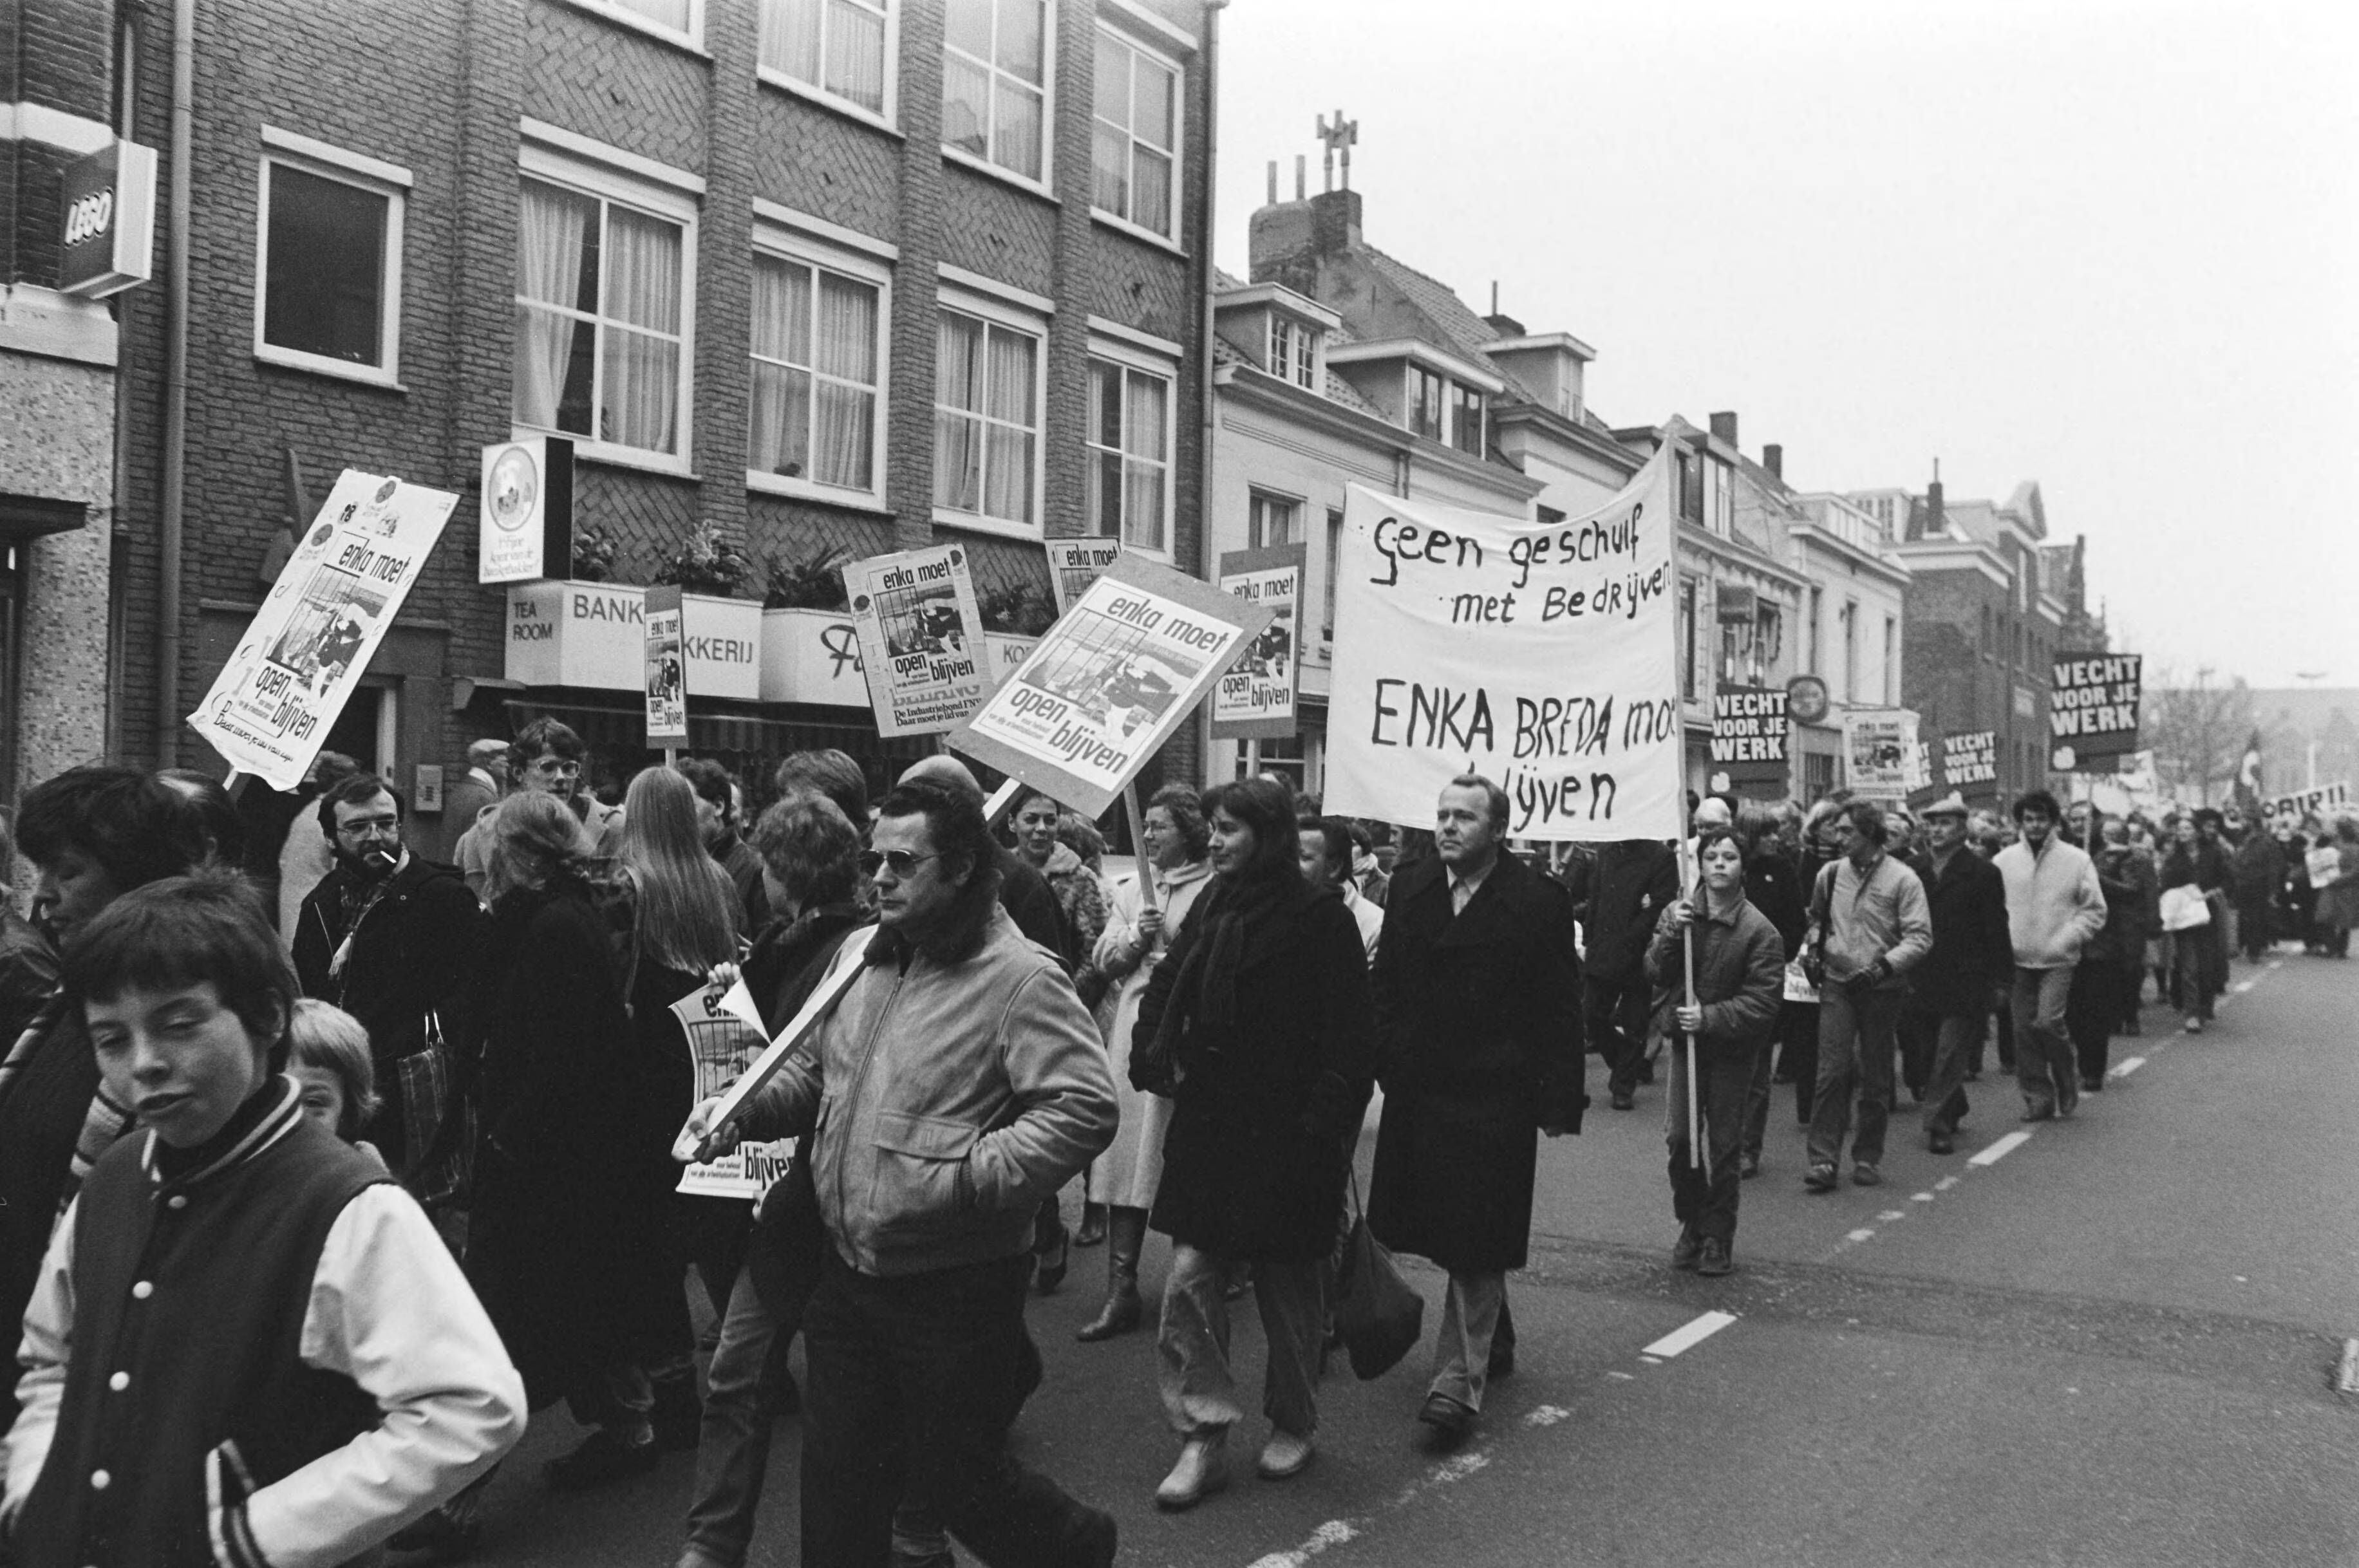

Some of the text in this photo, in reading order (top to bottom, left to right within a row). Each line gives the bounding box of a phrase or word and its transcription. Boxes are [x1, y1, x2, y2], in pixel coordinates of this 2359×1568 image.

[64, 189, 113, 246] LEGO
[339, 541, 411, 584] enka moet
[1066, 544, 1091, 566] enka
[1369, 517, 1481, 586] Geen
[883, 566, 915, 589] enka
[918, 558, 951, 582] moet
[1234, 574, 1293, 599] enka moet
[513, 601, 537, 619] TEA
[574, 594, 643, 624] BANK
[1452, 592, 1516, 624] met
[512, 623, 553, 640] ROOM
[651, 615, 679, 636] enka moet
[1107, 597, 1229, 653] enka moet
[684, 636, 753, 663] KKERIJ
[895, 653, 927, 677] open
[930, 658, 975, 684] blijven
[2053, 657, 2139, 687] VECHT
[256, 666, 292, 699] open
[1223, 675, 1250, 700] open
[2051, 682, 2139, 709] VOOR JE
[650, 699, 663, 717] open
[907, 701, 963, 716] Industriebond
[1010, 688, 1068, 723] open
[1251, 683, 1290, 713] blijven
[1715, 691, 1788, 717] VECHT
[270, 691, 318, 741] blijven
[664, 707, 684, 731] blijven
[1372, 678, 1494, 753] ENKA
[1514, 695, 1613, 758] BREDA
[1713, 716, 1786, 737] VOOR JE
[2050, 704, 2136, 736] WERK
[1048, 720, 1129, 774] blijven
[1710, 736, 1783, 761] WERK
[1944, 731, 1995, 754] VECHT
[1944, 763, 1997, 785] WERK
[702, 988, 738, 1018] en
